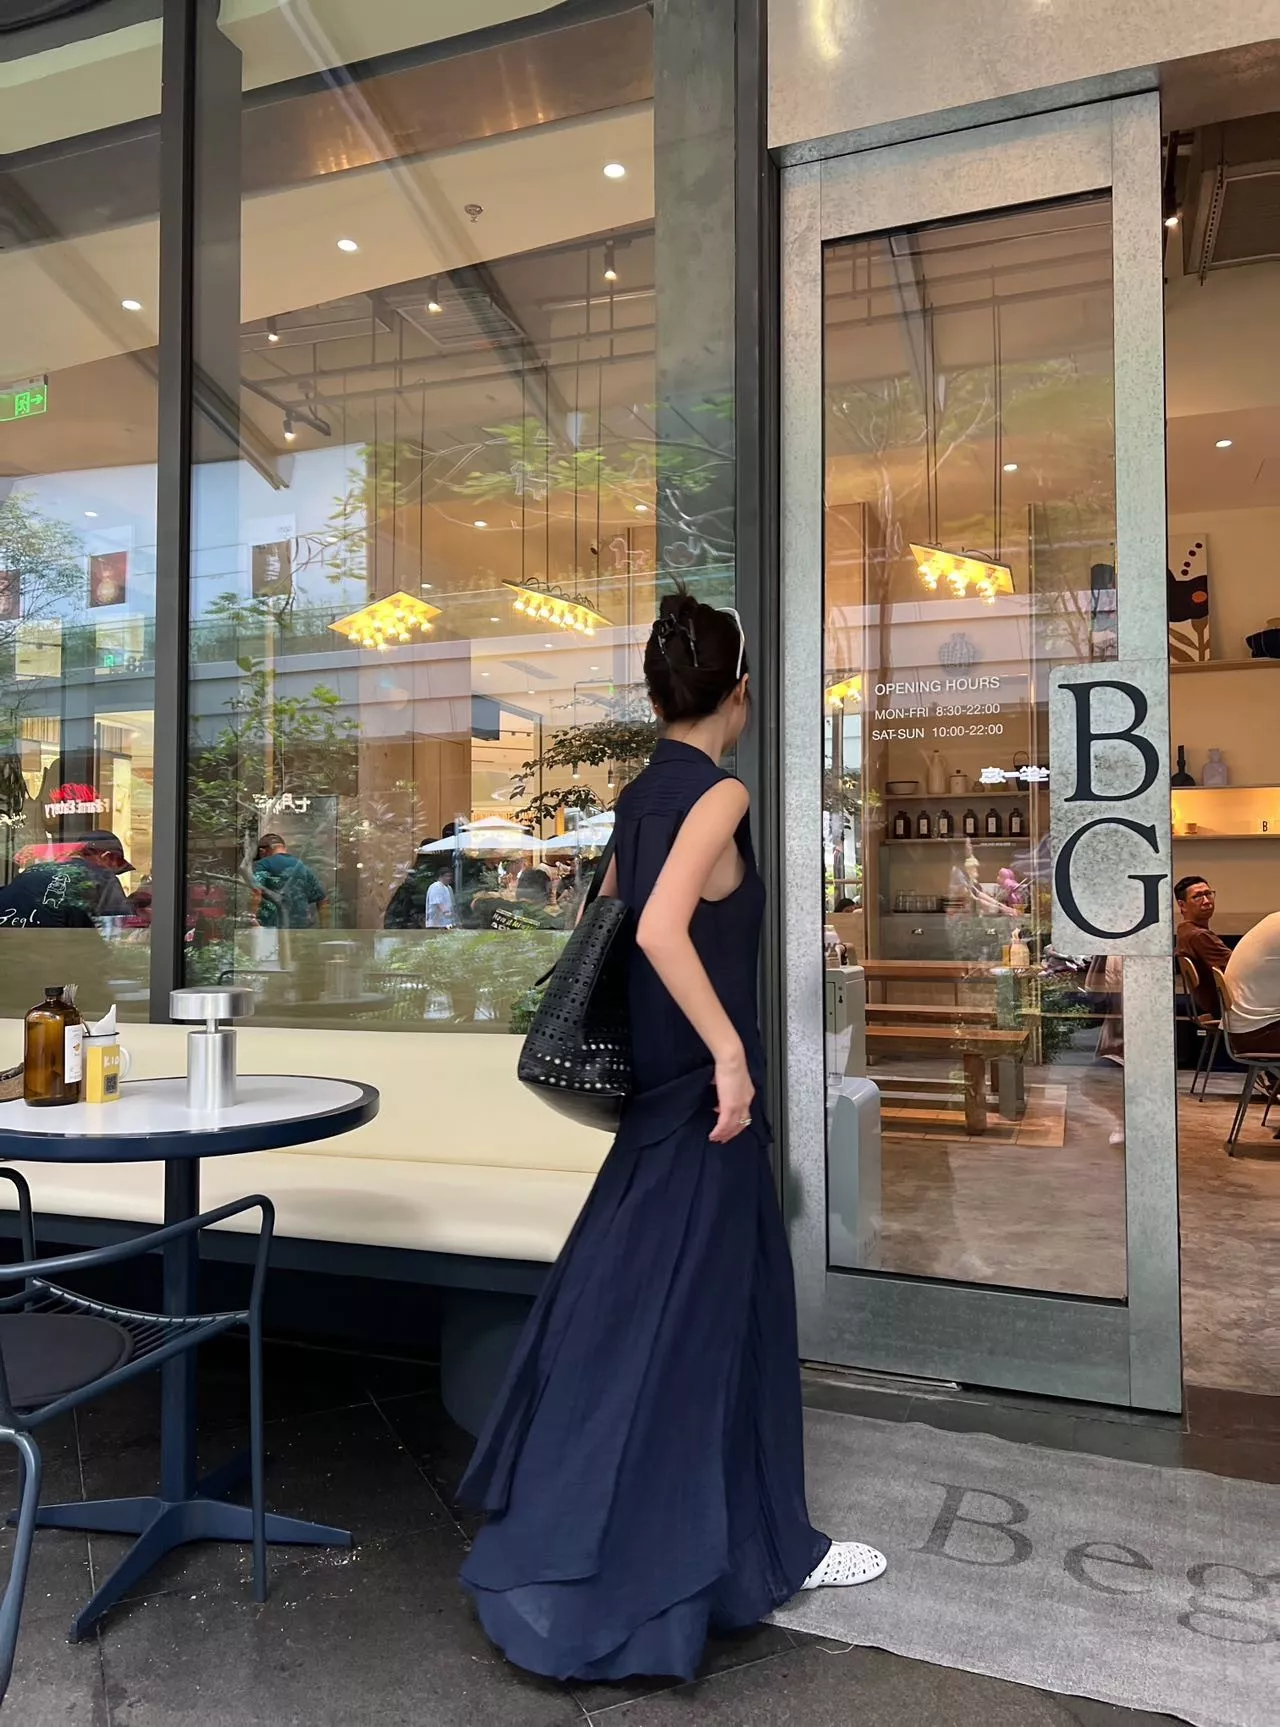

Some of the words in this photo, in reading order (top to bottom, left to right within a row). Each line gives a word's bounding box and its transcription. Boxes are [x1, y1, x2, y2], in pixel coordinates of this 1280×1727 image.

[875, 680, 941, 696] OPENING
[946, 676, 1000, 691] HOURS
[874, 707, 929, 720] MON-FRI
[935, 703, 1000, 716] 8:30-22:00
[872, 728, 925, 741] SAT-SUN
[932, 723, 1003, 738] 10:00-22:00
